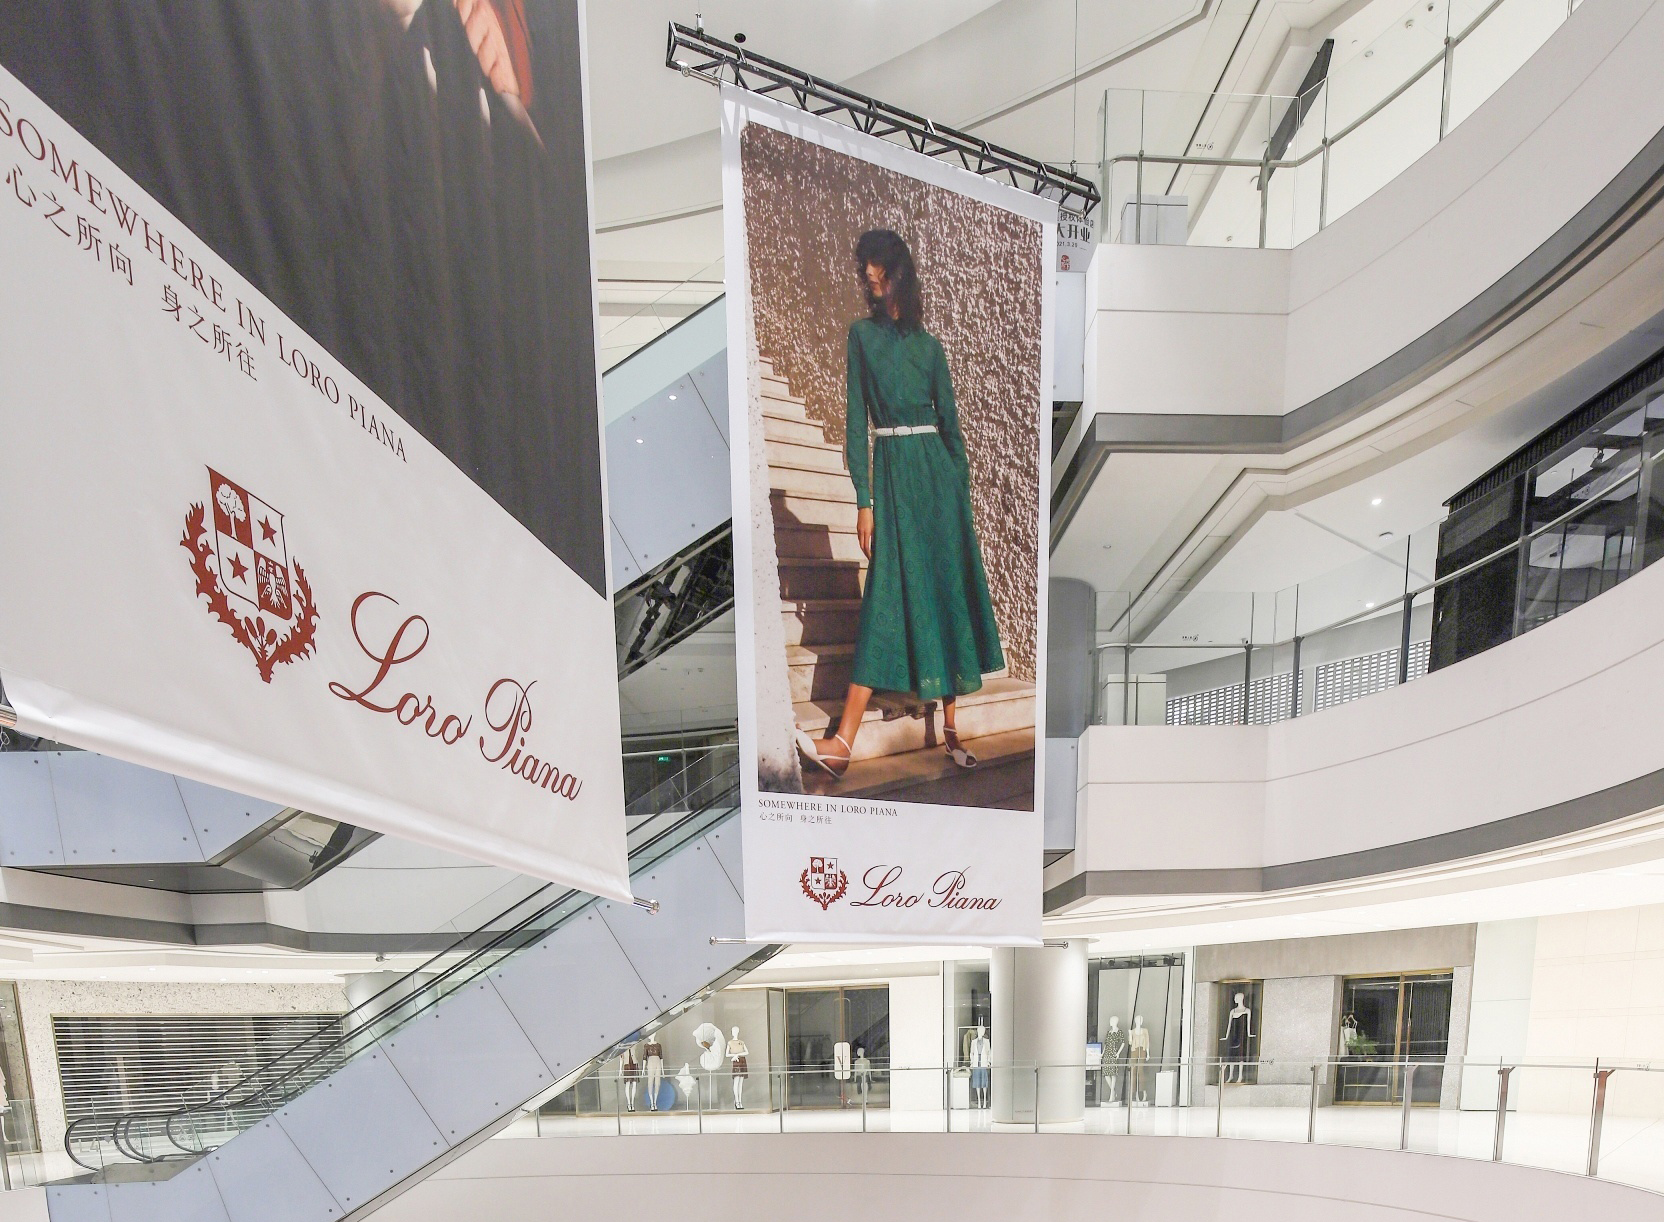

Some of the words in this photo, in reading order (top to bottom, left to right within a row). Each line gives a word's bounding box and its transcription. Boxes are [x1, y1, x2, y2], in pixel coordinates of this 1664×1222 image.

[0, 98, 226, 313] SOMEWHERE
[235, 298, 266, 346] IN
[276, 332, 340, 404] LORO
[348, 393, 407, 463] PIANA
[6, 163, 133, 286] 心之所向
[161, 284, 257, 381] 身之所往
[329, 591, 472, 745] Loro
[480, 679, 583, 801] Piana
[758, 799, 823, 812] SOMEWHERE
[826, 804, 837, 813] IN
[841, 805, 867, 815] LORO
[870, 807, 898, 817] PIANA
[760, 812, 793, 822] 心之所向
[850, 864, 924, 907] Loro
[928, 866, 1003, 911] Piana
